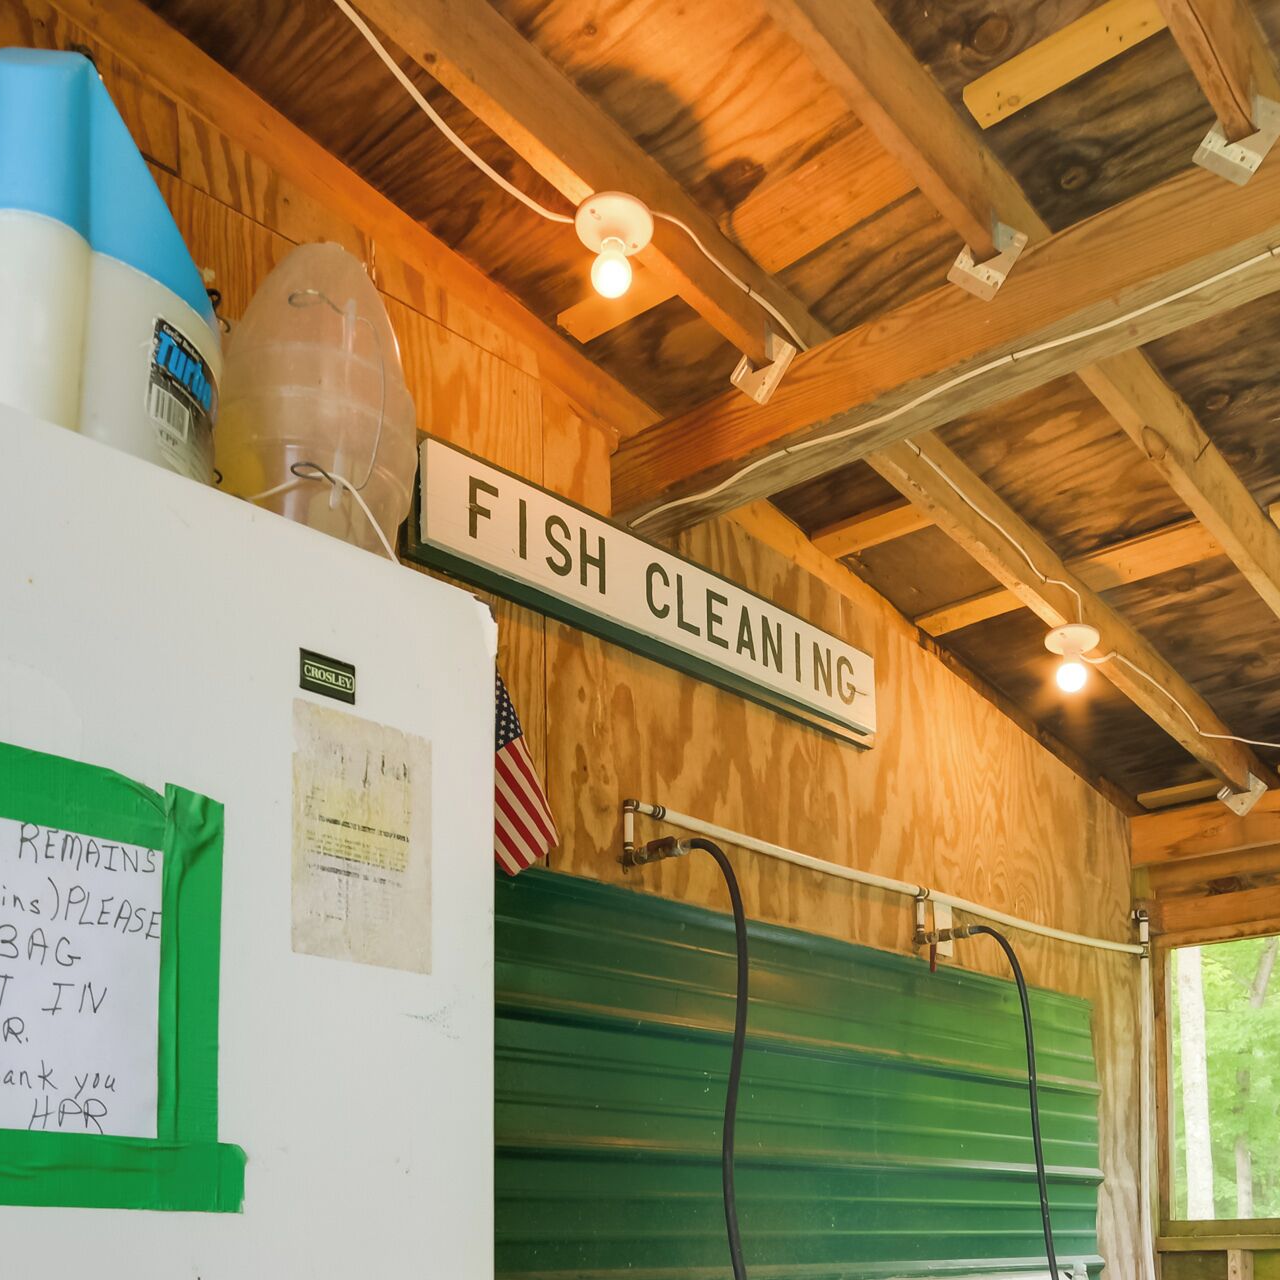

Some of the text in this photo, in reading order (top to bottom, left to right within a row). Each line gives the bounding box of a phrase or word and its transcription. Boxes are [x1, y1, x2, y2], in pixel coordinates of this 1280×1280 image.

[468, 475, 857, 706] FISH CLEANING
[303, 663, 353, 690] CROSLEY
[19, 822, 157, 874] REMAINS
[64, 885, 162, 941] PLEASE
[41, 982, 108, 1015] IN
[73, 1072, 117, 1100] you
